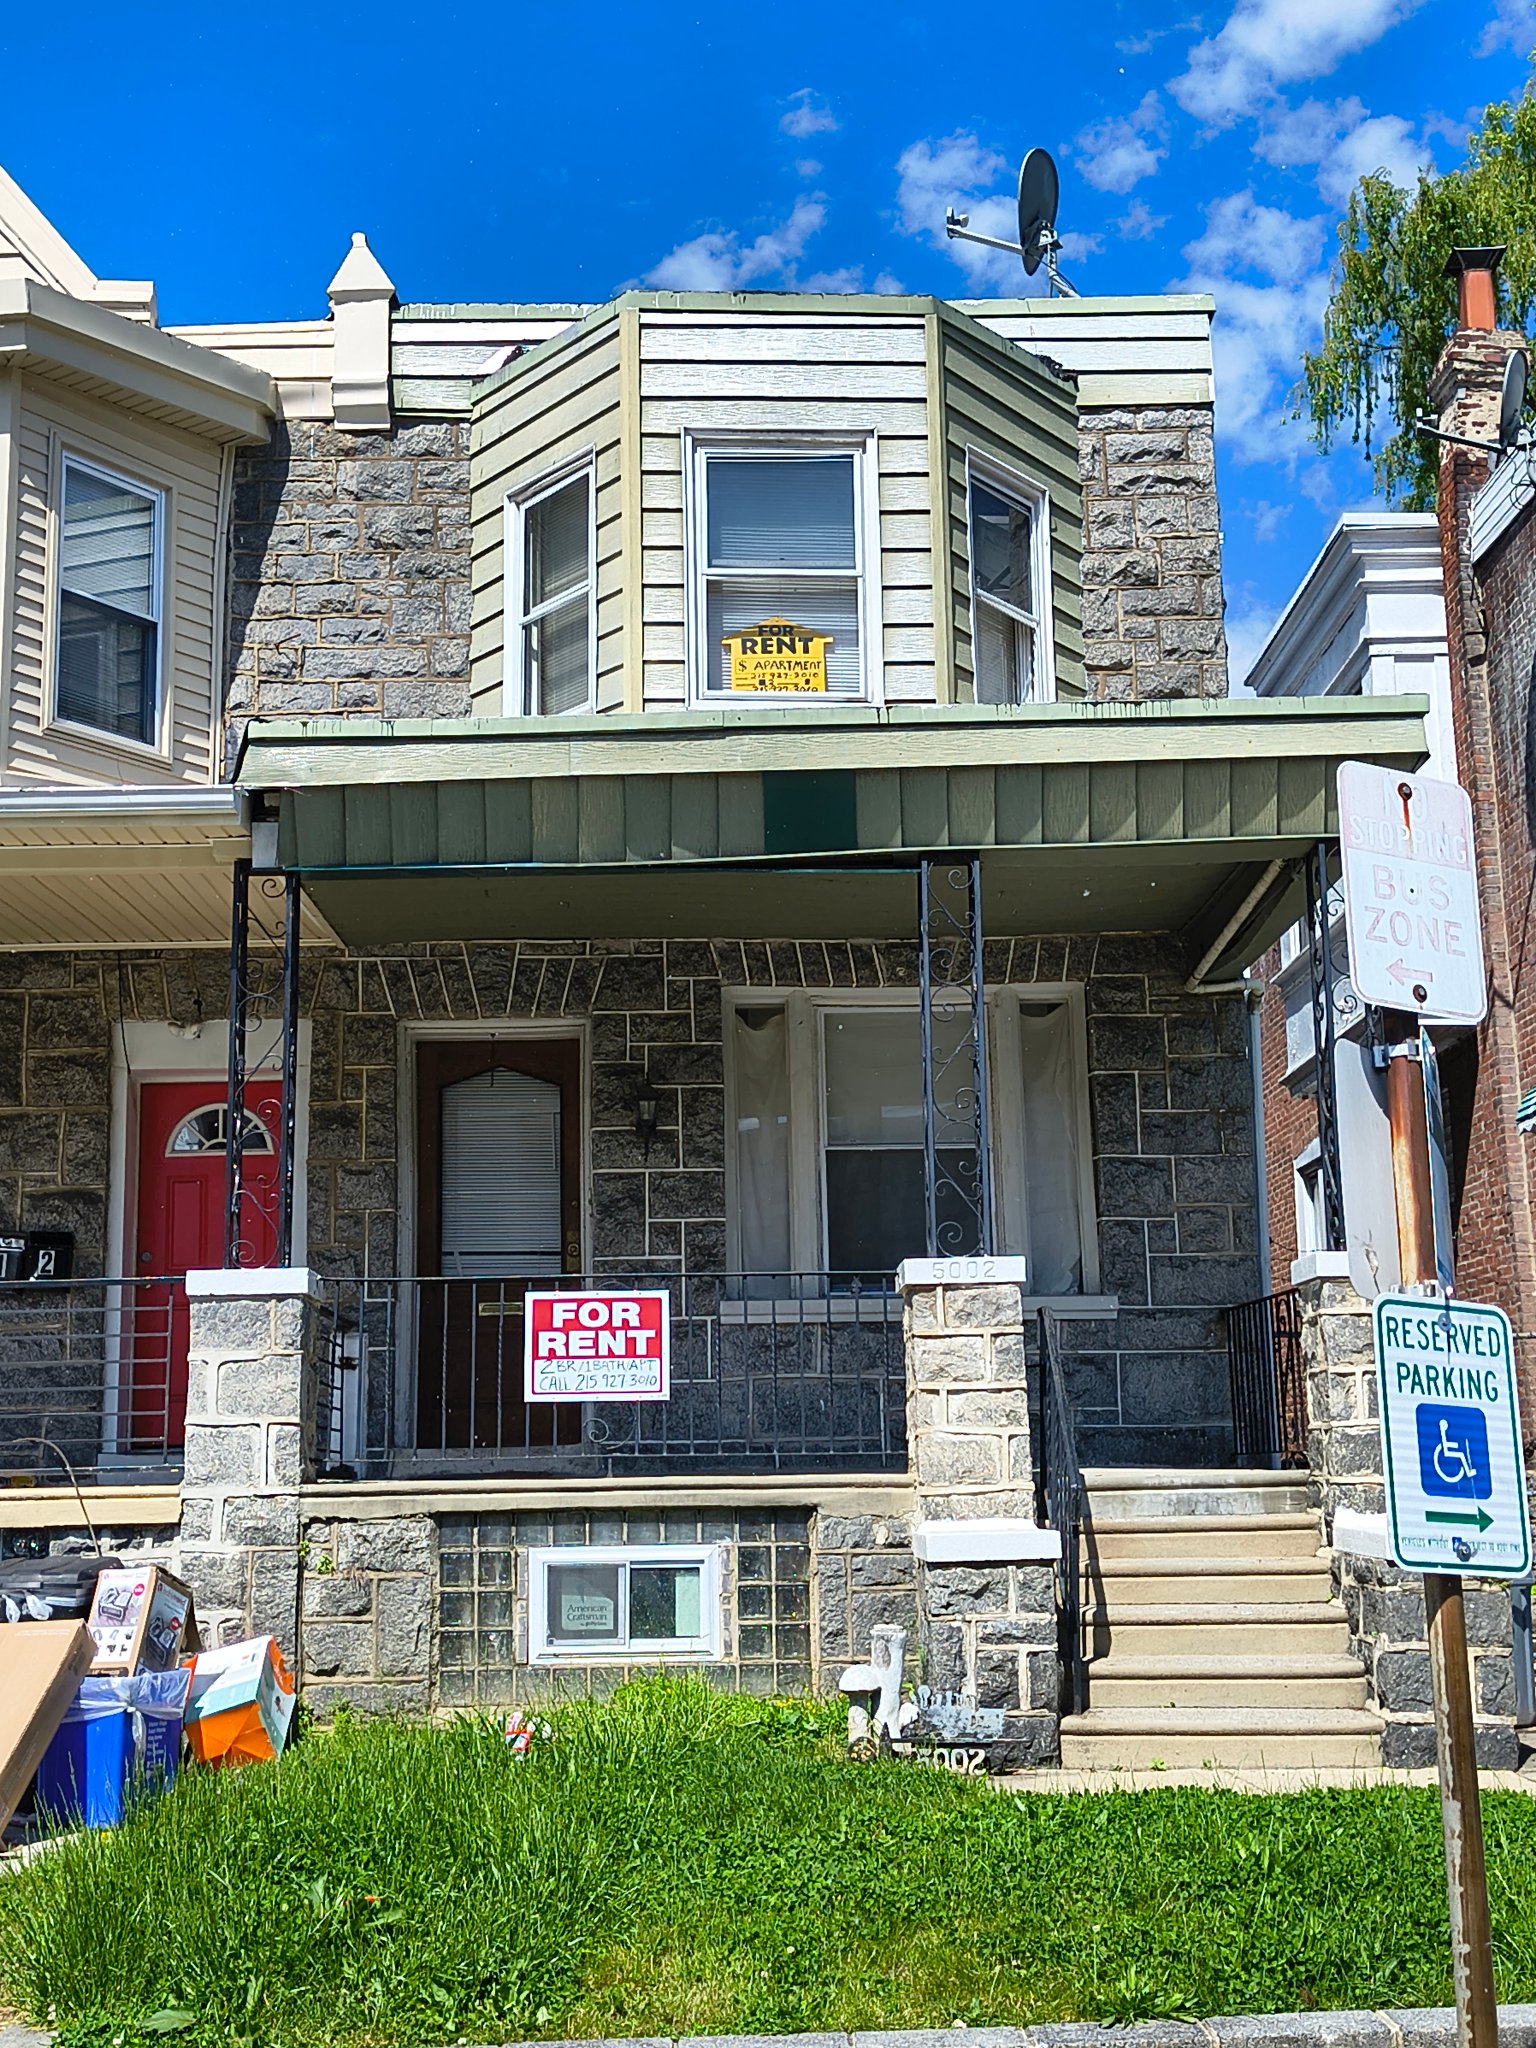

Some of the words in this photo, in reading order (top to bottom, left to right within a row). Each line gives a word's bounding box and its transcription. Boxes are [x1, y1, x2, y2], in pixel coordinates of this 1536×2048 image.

[758, 625, 794, 636] FOR
[741, 637, 814, 655] RENT
[738, 659, 748, 672] $
[1382, 774, 1430, 825] NO
[1349, 815, 1467, 865] STOPPING
[1372, 863, 1451, 911] BUS
[1364, 905, 1466, 958] ZONE
[40, 1252, 52, 1274] 2
[932, 1260, 997, 1280] 5002
[552, 1301, 641, 1328] FOR
[537, 1330, 656, 1357] RENT
[1386, 1315, 1501, 1358] RESERVED
[540, 1376, 571, 1392] CALL
[575, 1373, 598, 1392] 215
[601, 1373, 625, 1389] 927
[628, 1374, 658, 1388] 3010
[1396, 1361, 1499, 1403] PARKING
[567, 1604, 607, 1613] American
[567, 1613, 607, 1622] Craftsman
